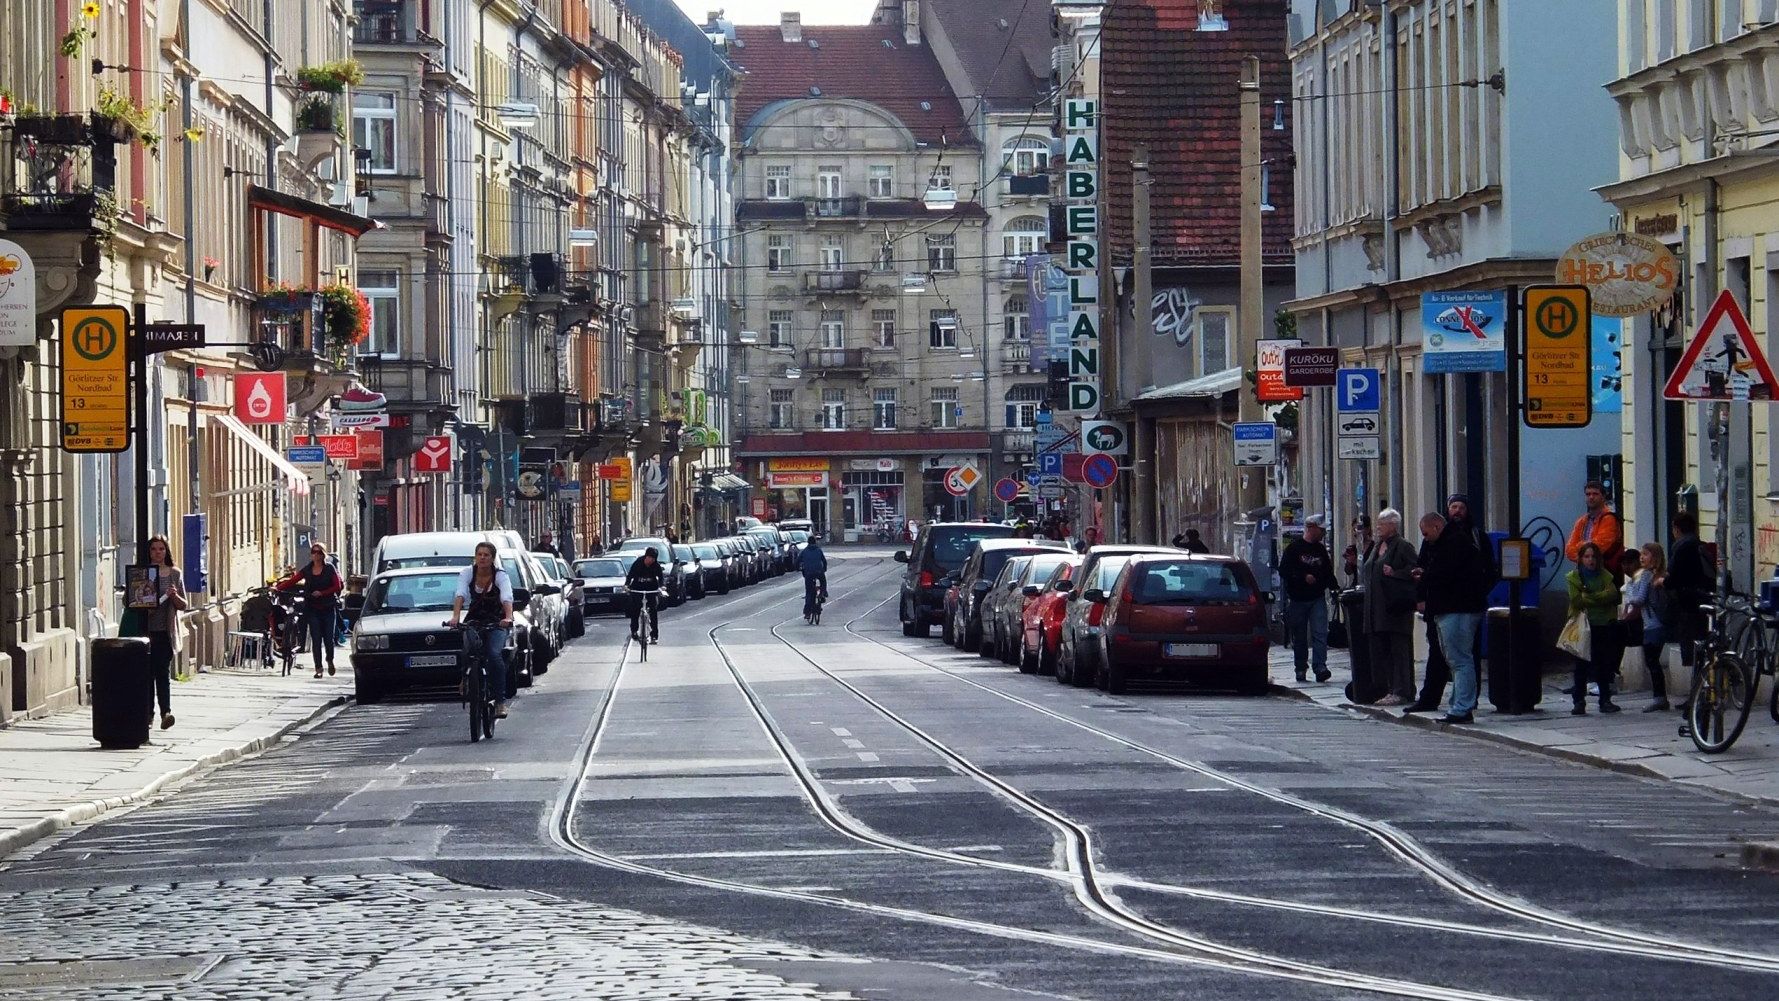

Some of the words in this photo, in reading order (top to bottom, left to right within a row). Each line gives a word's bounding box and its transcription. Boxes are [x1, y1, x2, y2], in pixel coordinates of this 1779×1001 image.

[1068, 102, 1097, 410] HABERLAND
[1563, 256, 1674, 289] HELIOS
[1592, 294, 1659, 313] ESTAURANT
[1540, 361, 1575, 369] Nordbad
[1289, 367, 1335, 375] GARDEROBE
[68, 374, 103, 383] Görlitzer
[1535, 374, 1549, 384] 13
[77, 384, 113, 392] Nordbad
[1346, 374, 1370, 406] P
[71, 398, 85, 409] 13
[1044, 455, 1057, 472] P
